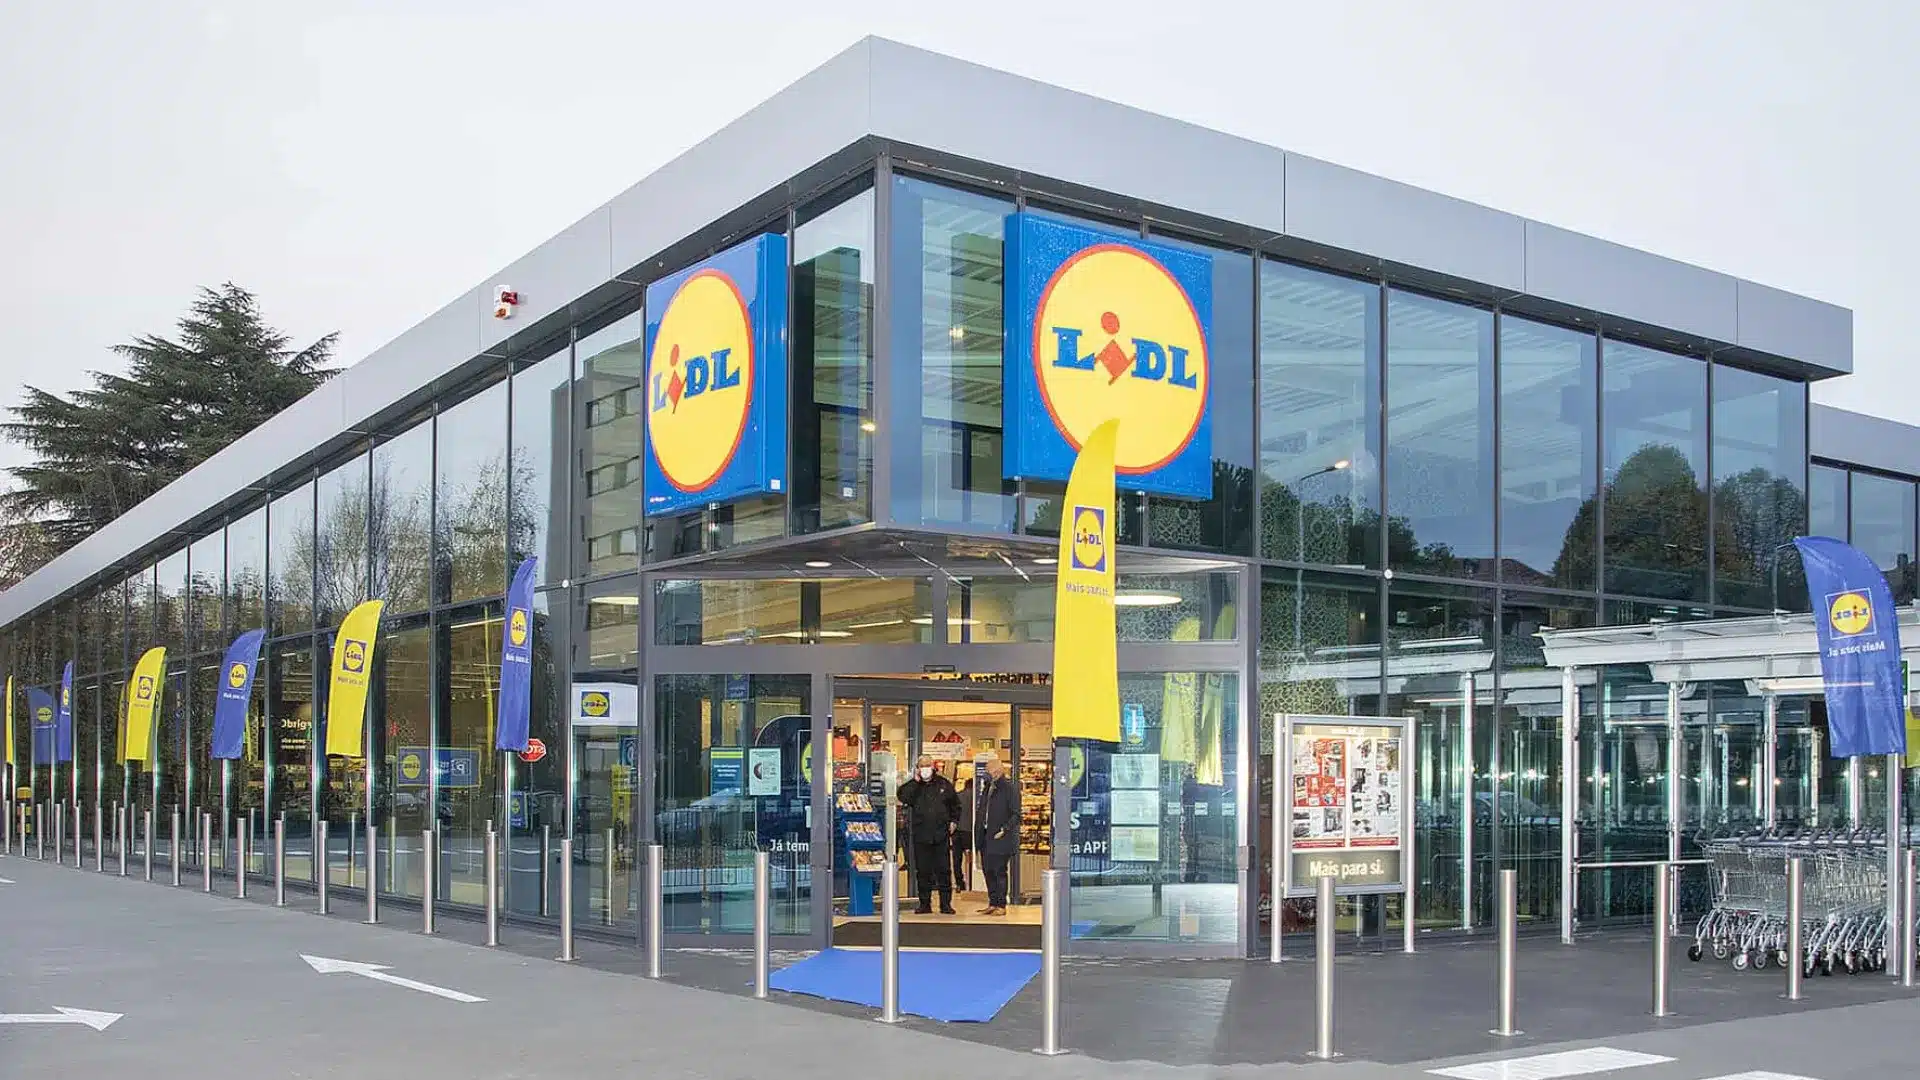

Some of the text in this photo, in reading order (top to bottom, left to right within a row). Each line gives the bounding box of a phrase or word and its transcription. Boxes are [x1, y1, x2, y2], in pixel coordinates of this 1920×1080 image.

[770, 839, 809, 852] Já tem
[1309, 859, 1385, 880] Mais para si.
